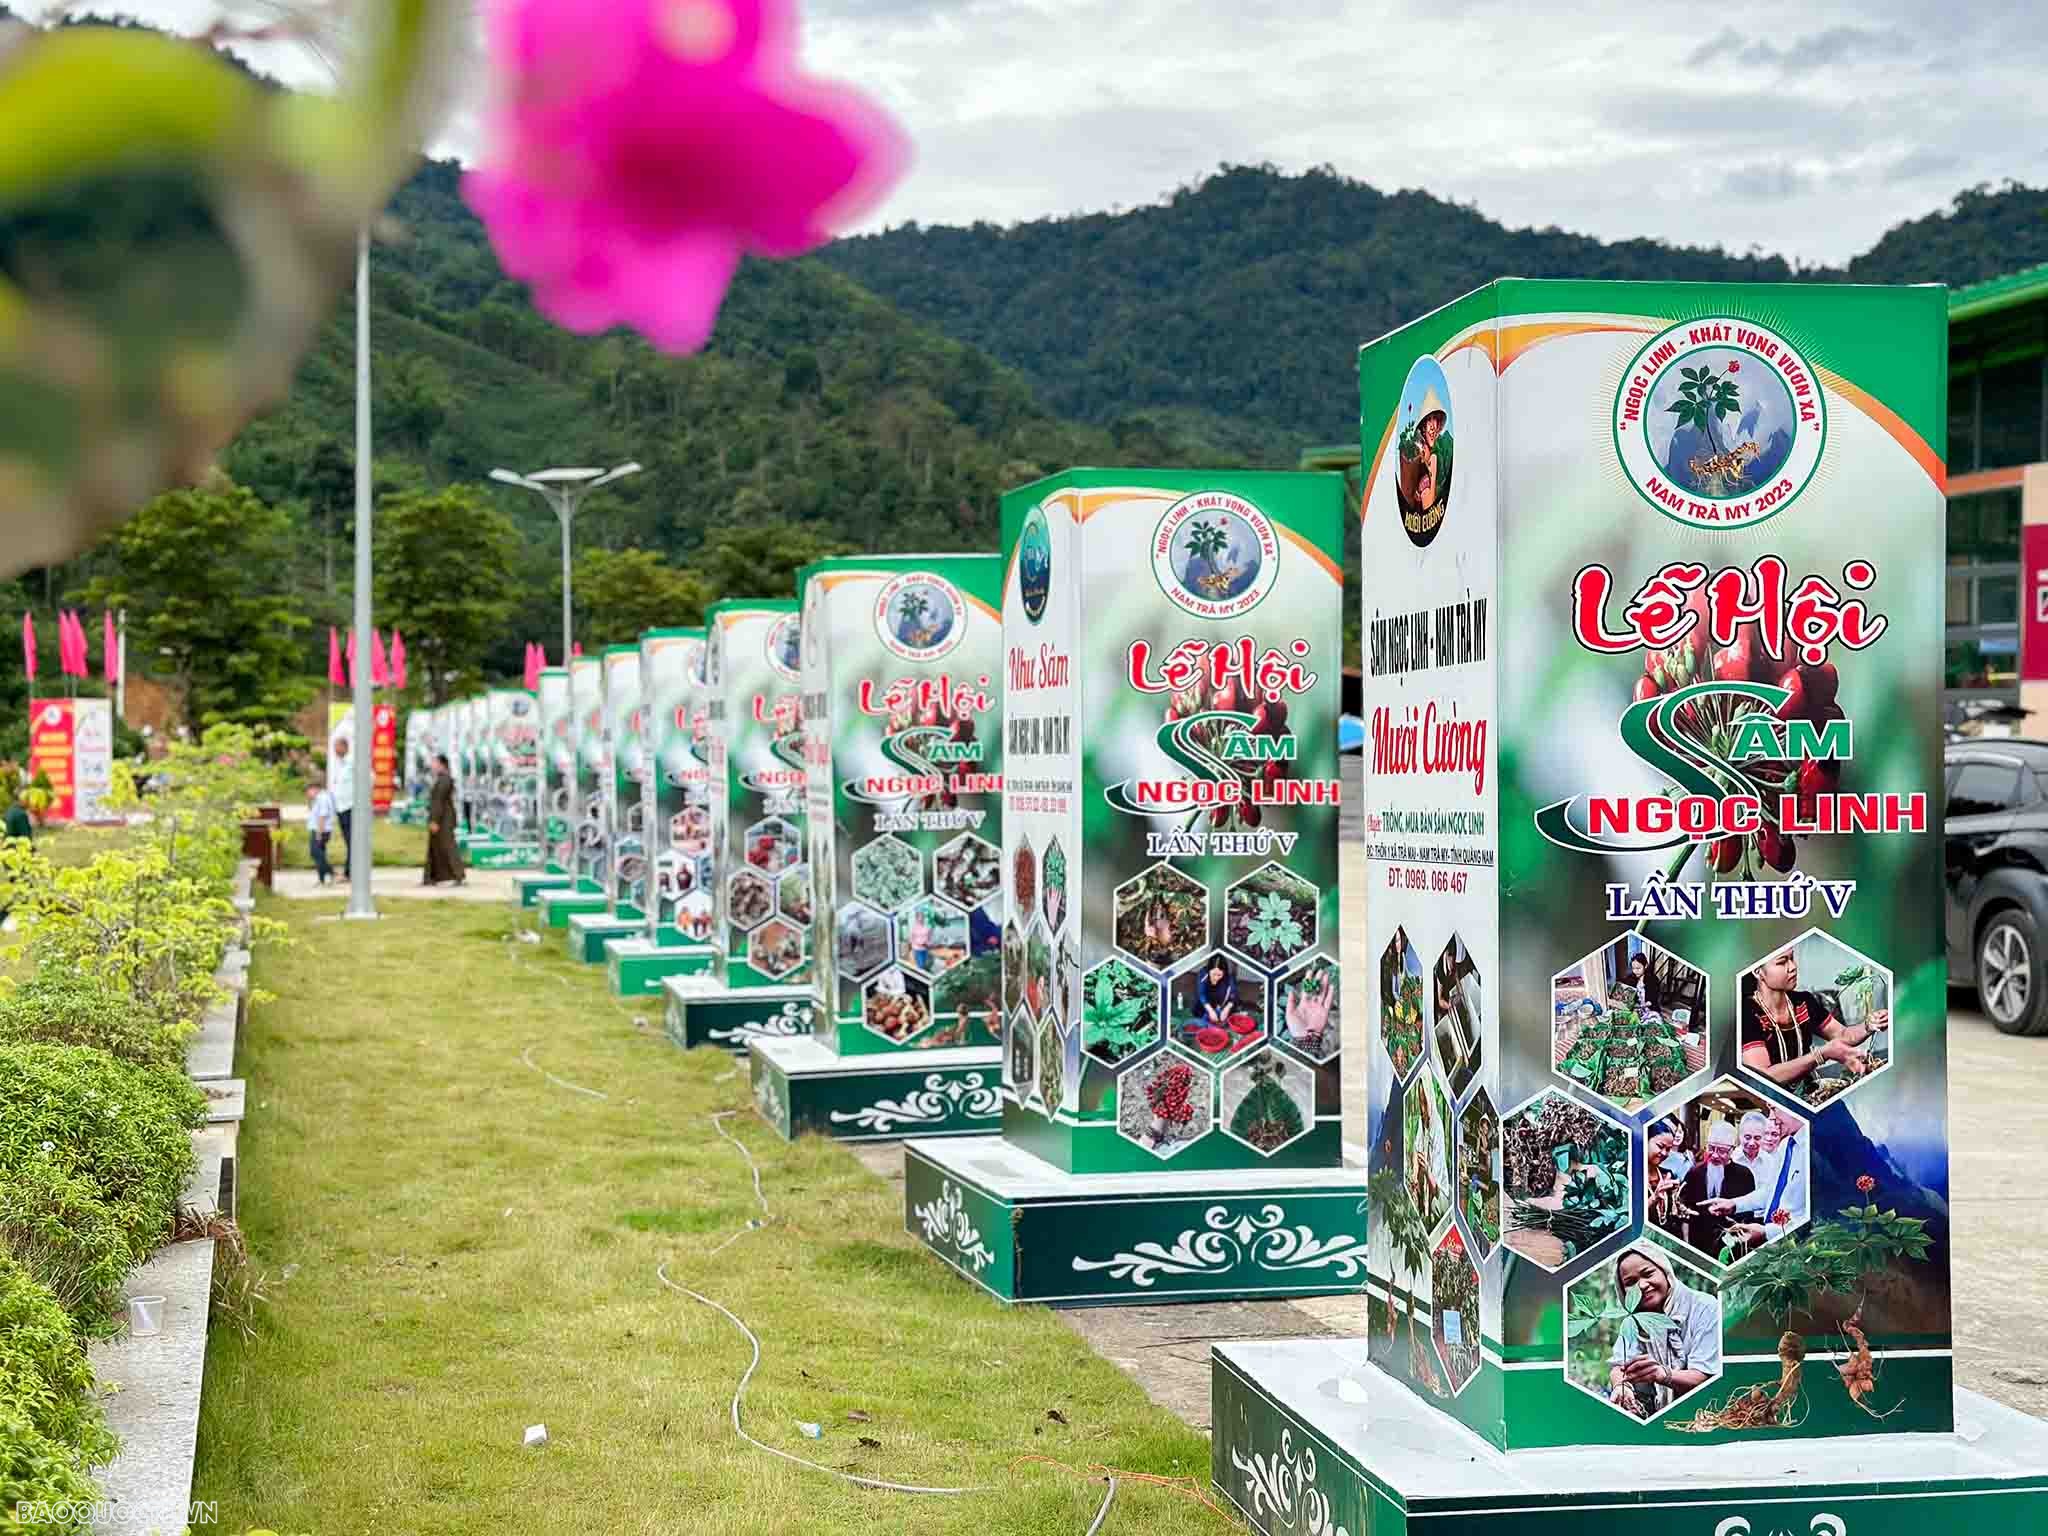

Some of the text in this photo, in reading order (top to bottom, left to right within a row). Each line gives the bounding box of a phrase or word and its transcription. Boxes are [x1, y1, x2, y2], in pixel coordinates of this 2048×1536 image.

[1642, 340, 1677, 376] LINH
[1688, 322, 1732, 345] KHÁT
[1736, 328, 1779, 359] VỌNG
[1777, 353, 1810, 397] VƯƠN
[1646, 476, 1793, 521] NAM TRÀ MY 2023
[1170, 586, 1194, 608] NAM
[1572, 554, 1888, 665] Lễ Hội
[1410, 610, 1429, 672] LINH
[1435, 604, 1454, 669] NAM
[1474, 597, 1488, 662] MY
[1039, 642, 1069, 689] Sâm
[1128, 635, 1319, 703] Lễ Hội
[1372, 701, 1488, 796] Mười Cường
[1136, 779, 1342, 809] NGỌC LINH
[1587, 793, 1927, 840] NGỌC LINH
[1147, 826, 1298, 856] LẦN THỨ V
[1431, 870, 1448, 892] 066
[1451, 872, 1468, 894] 467
[1606, 869, 1857, 920] LẦN THỨ V
